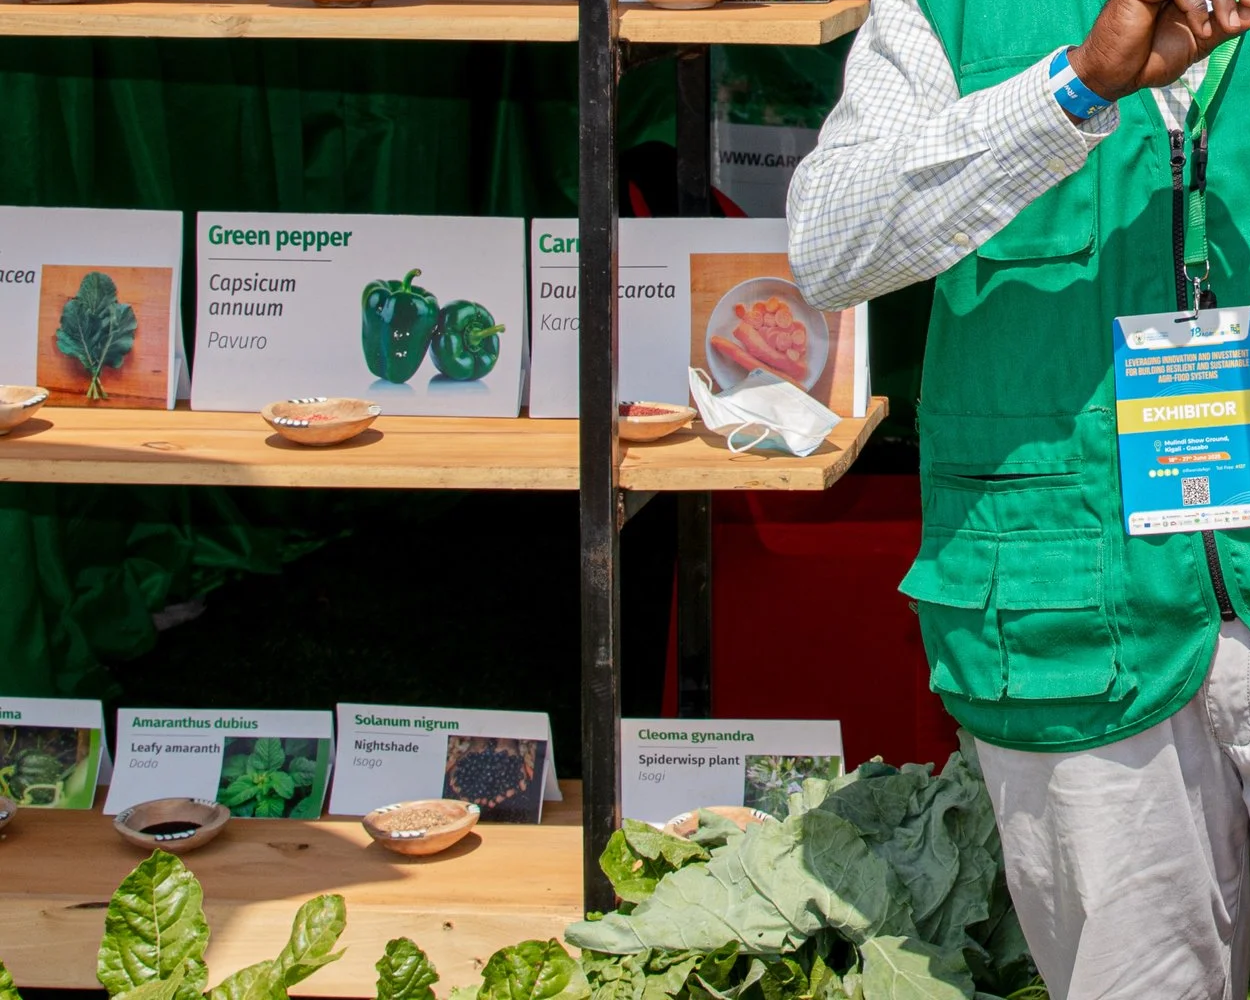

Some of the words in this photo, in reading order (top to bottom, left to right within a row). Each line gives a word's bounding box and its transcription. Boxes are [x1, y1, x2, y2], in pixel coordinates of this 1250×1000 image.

[719, 151, 803, 168] WWW.GAR
[208, 224, 271, 246] Green
[276, 229, 352, 252] pepper
[209, 273, 296, 295] Capsicum
[540, 282, 577, 299] Dau
[617, 282, 676, 299] carota
[209, 301, 283, 317] annuum
[541, 313, 580, 331] Karo
[208, 331, 267, 350] Pavuro
[1212, 349, 1249, 360] INVESTMENT
[1142, 401, 1237, 423] EXHIBITOR
[132, 716, 211, 728] Amaranthus
[214, 716, 258, 729] dubius
[355, 714, 411, 727] Solanum
[414, 716, 459, 731] nigrum
[638, 729, 688, 741] Cleoma
[691, 730, 755, 743] gynandra
[131, 742, 162, 755] Leafy
[165, 743, 220, 754] amaranth
[354, 739, 419, 753] Nightshade
[129, 758, 159, 769] Dodo
[353, 756, 382, 769] Isogo
[638, 754, 706, 767] Spiderwisp
[708, 754, 740, 767] plant
[638, 770, 666, 783] Isogi
